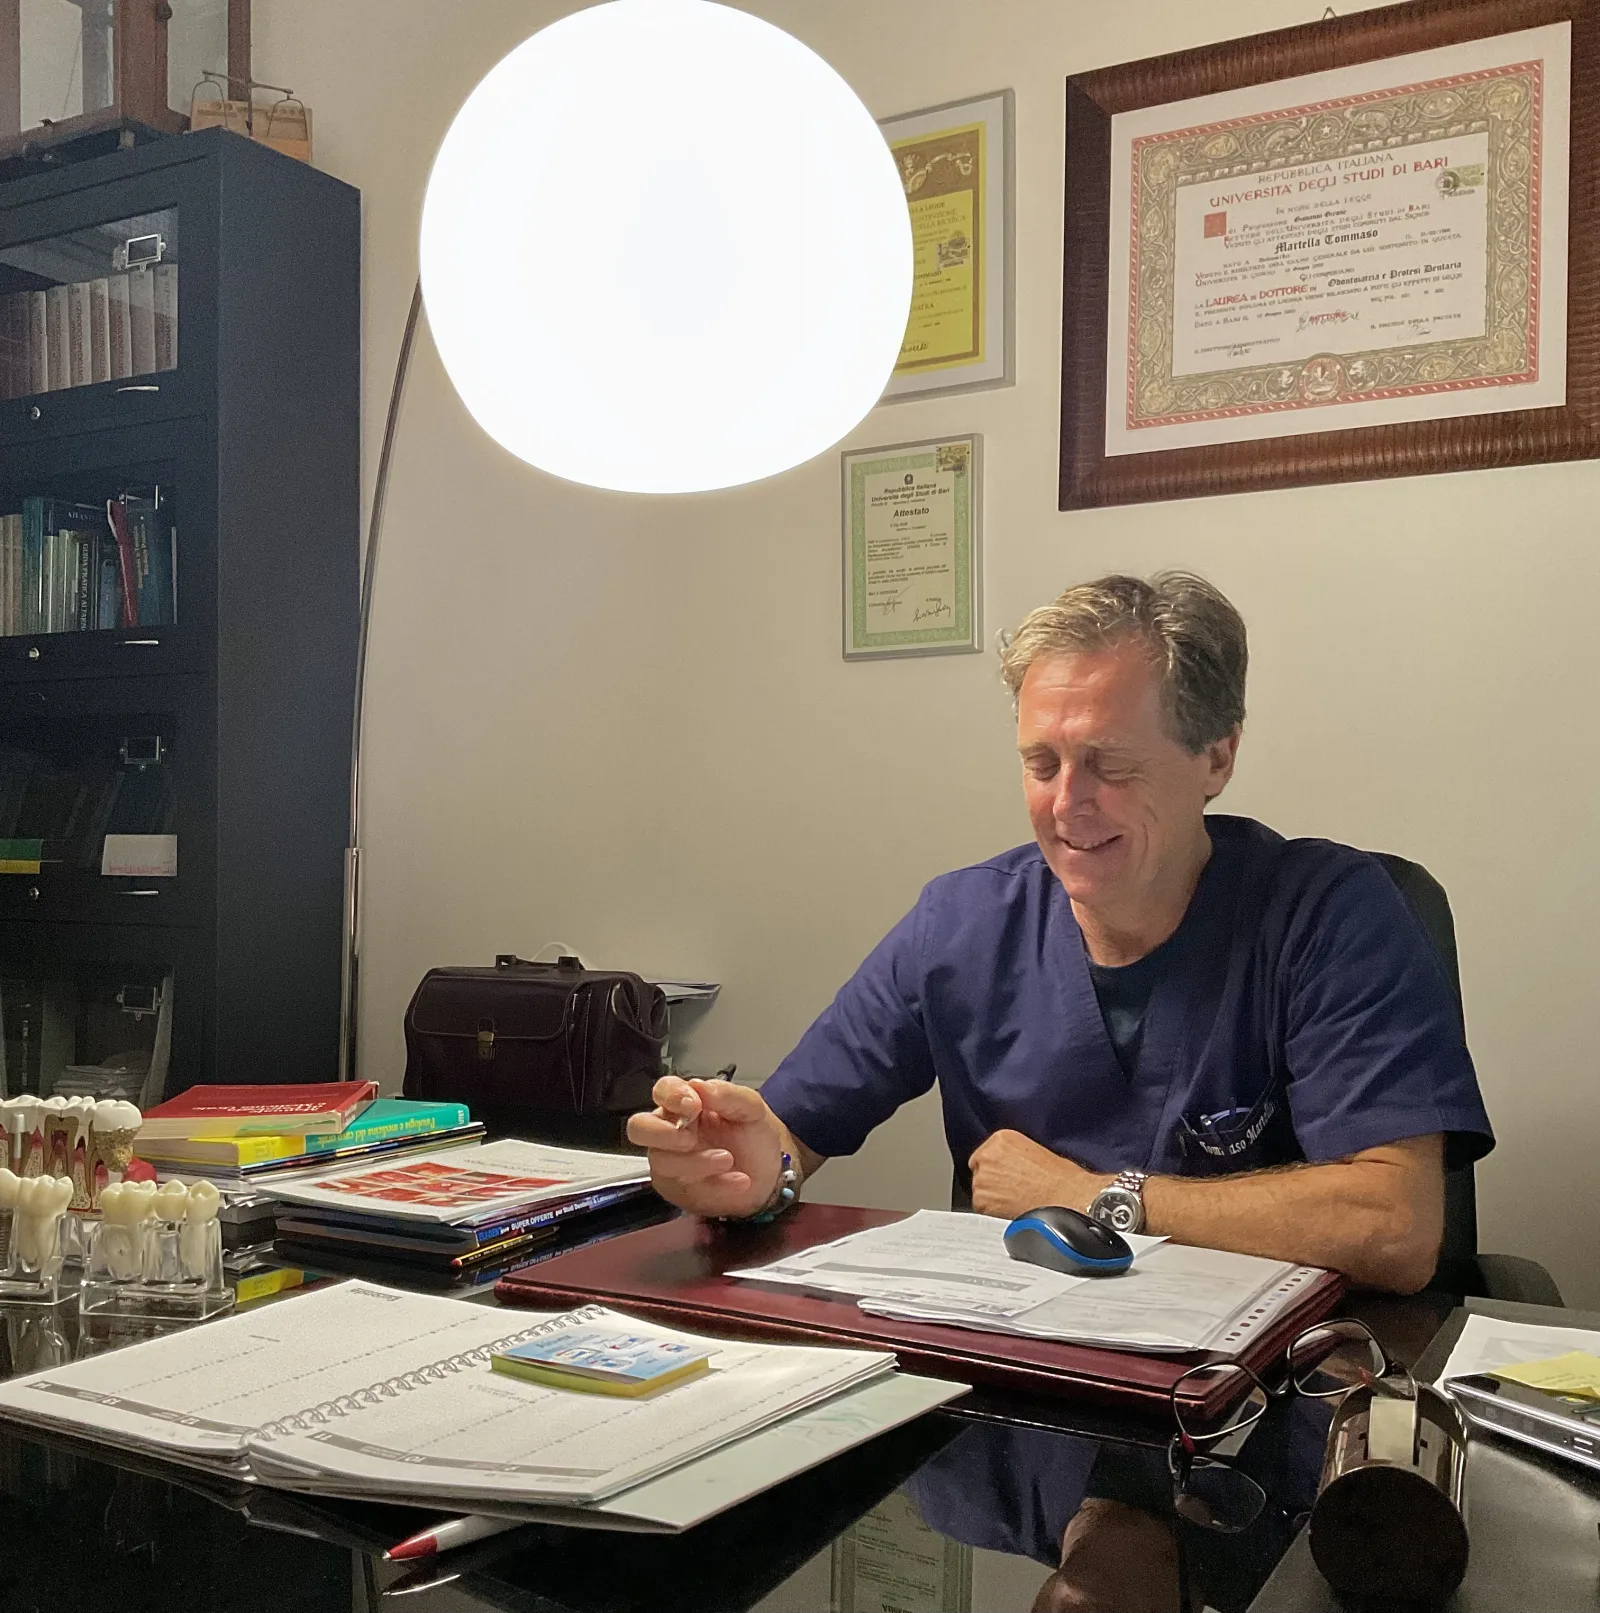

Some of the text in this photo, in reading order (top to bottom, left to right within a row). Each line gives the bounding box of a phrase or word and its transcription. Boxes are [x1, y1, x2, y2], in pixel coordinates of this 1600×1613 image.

[1258, 152, 1394, 183] REPUBBLICA ITALIANA
[1299, 175, 1337, 192] DEGLI
[1343, 167, 1384, 184] STUDI
[1393, 163, 1407, 176] DI
[1413, 156, 1448, 172] BARI
[1314, 199, 1340, 209] DELLA
[1408, 203, 1431, 213] BARI
[1267, 231, 1305, 242] ATTESTATI
[1274, 228, 1379, 255] Martella Tommaso
[1432, 231, 1462, 243] QUESTA
[1328, 274, 1380, 288] Odontoiatria
[1389, 266, 1421, 280] Protesi
[1424, 261, 1462, 273] Dentaria
[1205, 293, 1249, 309] LAUREA
[1259, 284, 1308, 300] DOTTORE
[883, 486, 915, 495] Repubblica
[900, 492, 915, 500] degli
[915, 489, 930, 497] Studi
[930, 488, 937, 496] di
[937, 487, 950, 495] Bari
[893, 506, 930, 518] Attestato
[81, 567, 89, 598] PRATICA
[355, 1129, 367, 1143] del
[367, 1124, 399, 1140] medicina
[511, 1219, 531, 1231] SUPER
[530, 1212, 554, 1227] OFFERTE
